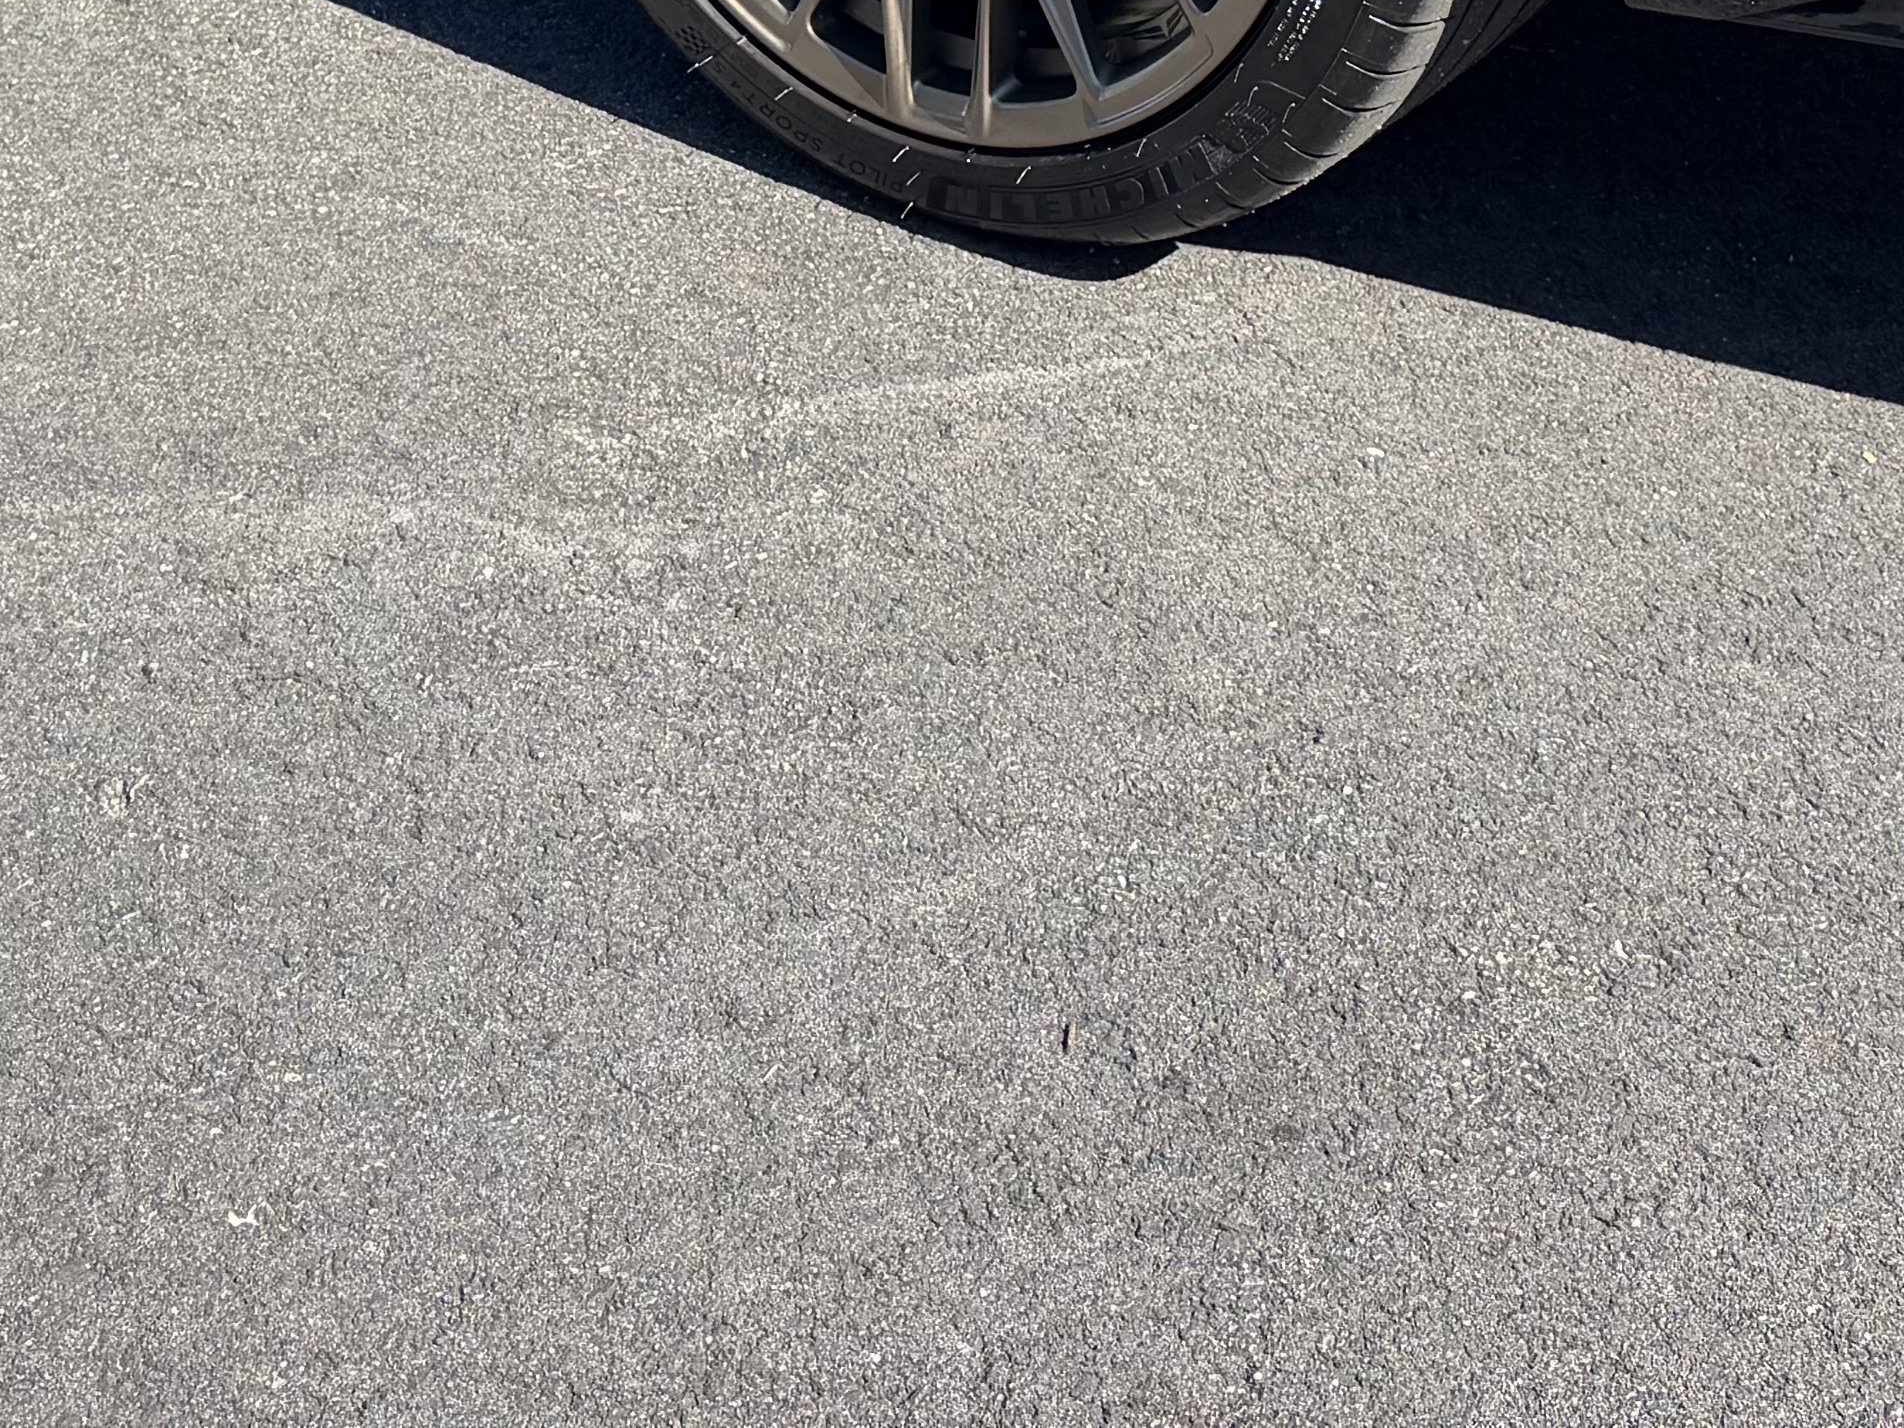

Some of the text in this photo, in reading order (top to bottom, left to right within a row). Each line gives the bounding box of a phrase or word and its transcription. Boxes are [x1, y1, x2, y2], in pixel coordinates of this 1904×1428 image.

[711, 60, 726, 76] S
[743, 91, 824, 153] SPORT
[833, 149, 903, 194] PILOT
[946, 141, 1210, 221] MICHELIN
